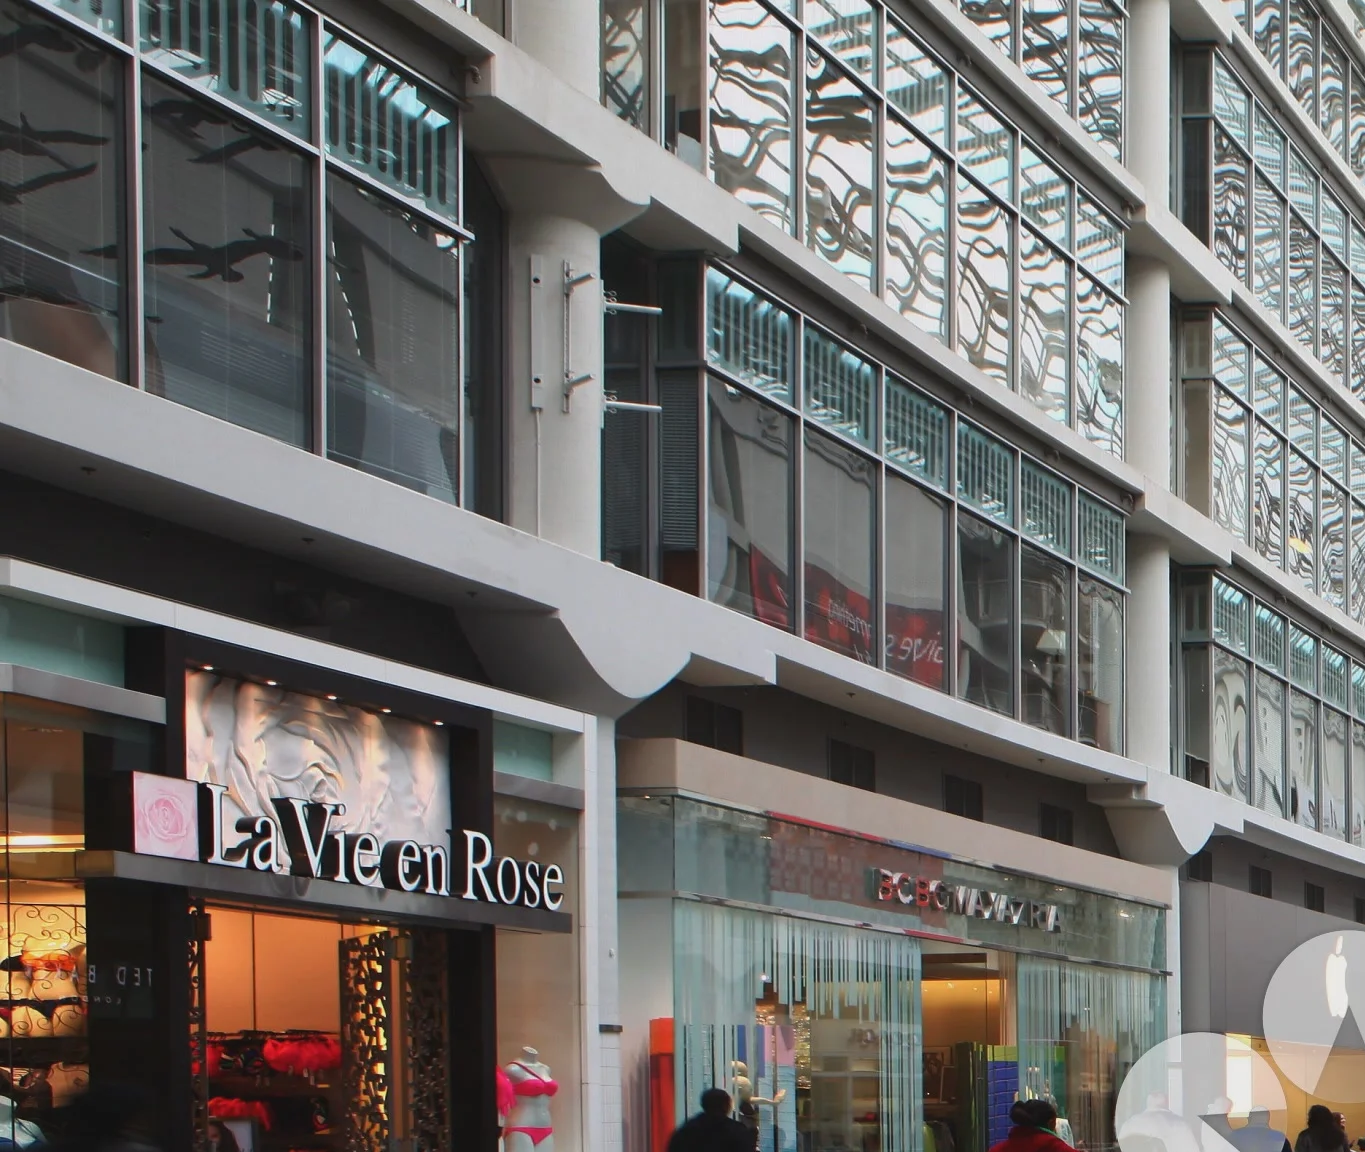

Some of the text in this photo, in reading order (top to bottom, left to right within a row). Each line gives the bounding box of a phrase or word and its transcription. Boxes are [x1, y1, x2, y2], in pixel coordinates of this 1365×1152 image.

[206, 782, 565, 912] La Vie en Rose
